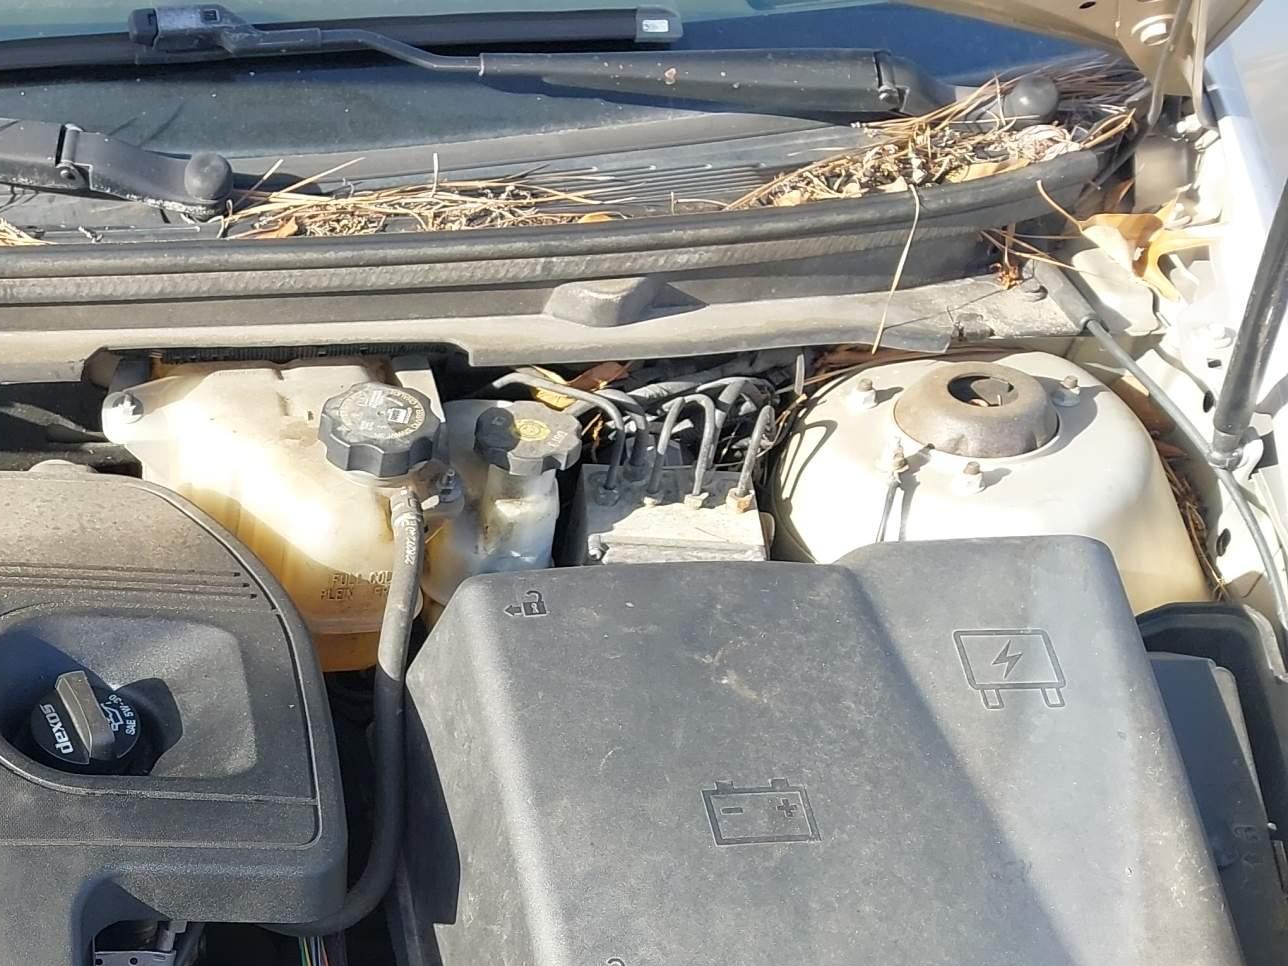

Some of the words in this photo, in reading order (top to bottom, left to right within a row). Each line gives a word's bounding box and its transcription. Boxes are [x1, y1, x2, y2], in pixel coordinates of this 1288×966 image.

[368, 569, 393, 585] COL
[108, 694, 134, 718] 5W-30
[40, 703, 74, 754] dexos
[126, 719, 136, 735] SAE
